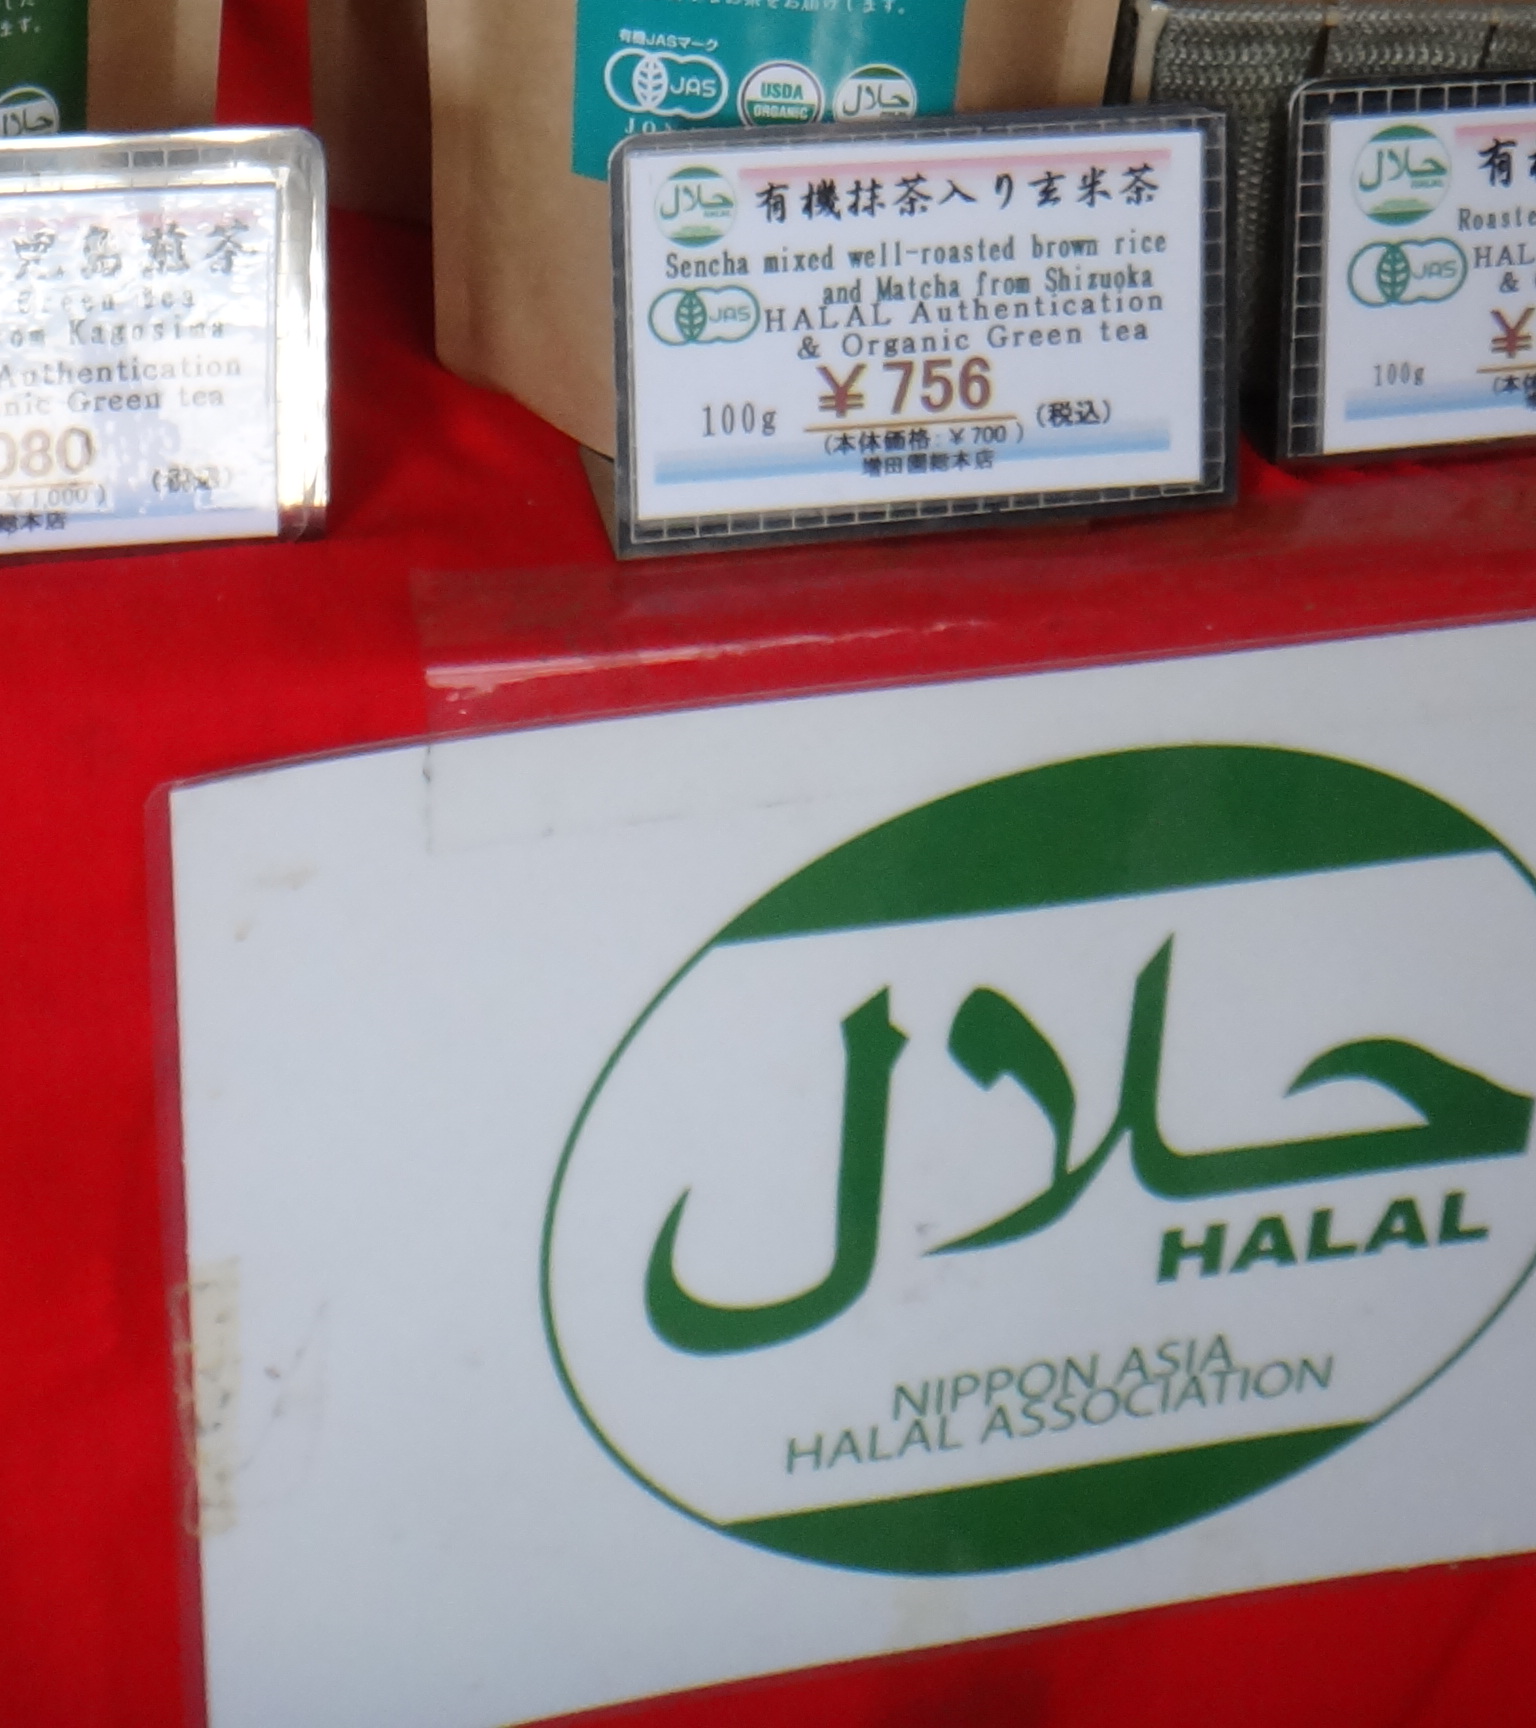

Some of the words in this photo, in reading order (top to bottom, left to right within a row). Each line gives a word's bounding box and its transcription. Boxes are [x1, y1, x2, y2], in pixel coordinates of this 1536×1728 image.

[671, 77, 717, 98] JAS
[761, 82, 802, 100] USDA
[843, 83, 910, 116] حلال
[1359, 146, 1447, 192] حلال
[660, 184, 734, 218] حلال
[756, 163, 1161, 222] 有機抹茶入り玄米茶
[665, 251, 749, 279] Sencha
[764, 245, 834, 274] mixed
[849, 236, 1016, 269] well-roasted
[1031, 234, 1099, 260] brown
[1115, 229, 1168, 255] rice
[1413, 260, 1456, 279] JAS
[822, 281, 863, 306] and
[877, 274, 962, 303] Matcha
[976, 271, 1031, 298] from
[1044, 266, 1154, 295] Shizuoka
[1499, 272, 1520, 294] &
[709, 306, 751, 323] JAS
[764, 303, 894, 334] HALAL
[910, 290, 1163, 325] Authentication
[797, 335, 821, 360] &
[841, 328, 971, 361] Organic
[987, 322, 1083, 351] Green
[1101, 320, 1149, 343] tea
[1372, 362, 1425, 388] 100g
[66, 386, 161, 413] Green
[179, 386, 224, 408] tea
[1036, 399, 1112, 428] (税込)
[701, 402, 778, 439] 100g
[644, 931, 1536, 1357] حلال
[1156, 1192, 1489, 1283] HALAL
[892, 1353, 1100, 1423] NIPPON
[1119, 1331, 1235, 1388] ASIA
[786, 1415, 963, 1476] HALAL
[980, 1355, 1334, 1445] ASSOCIATION
